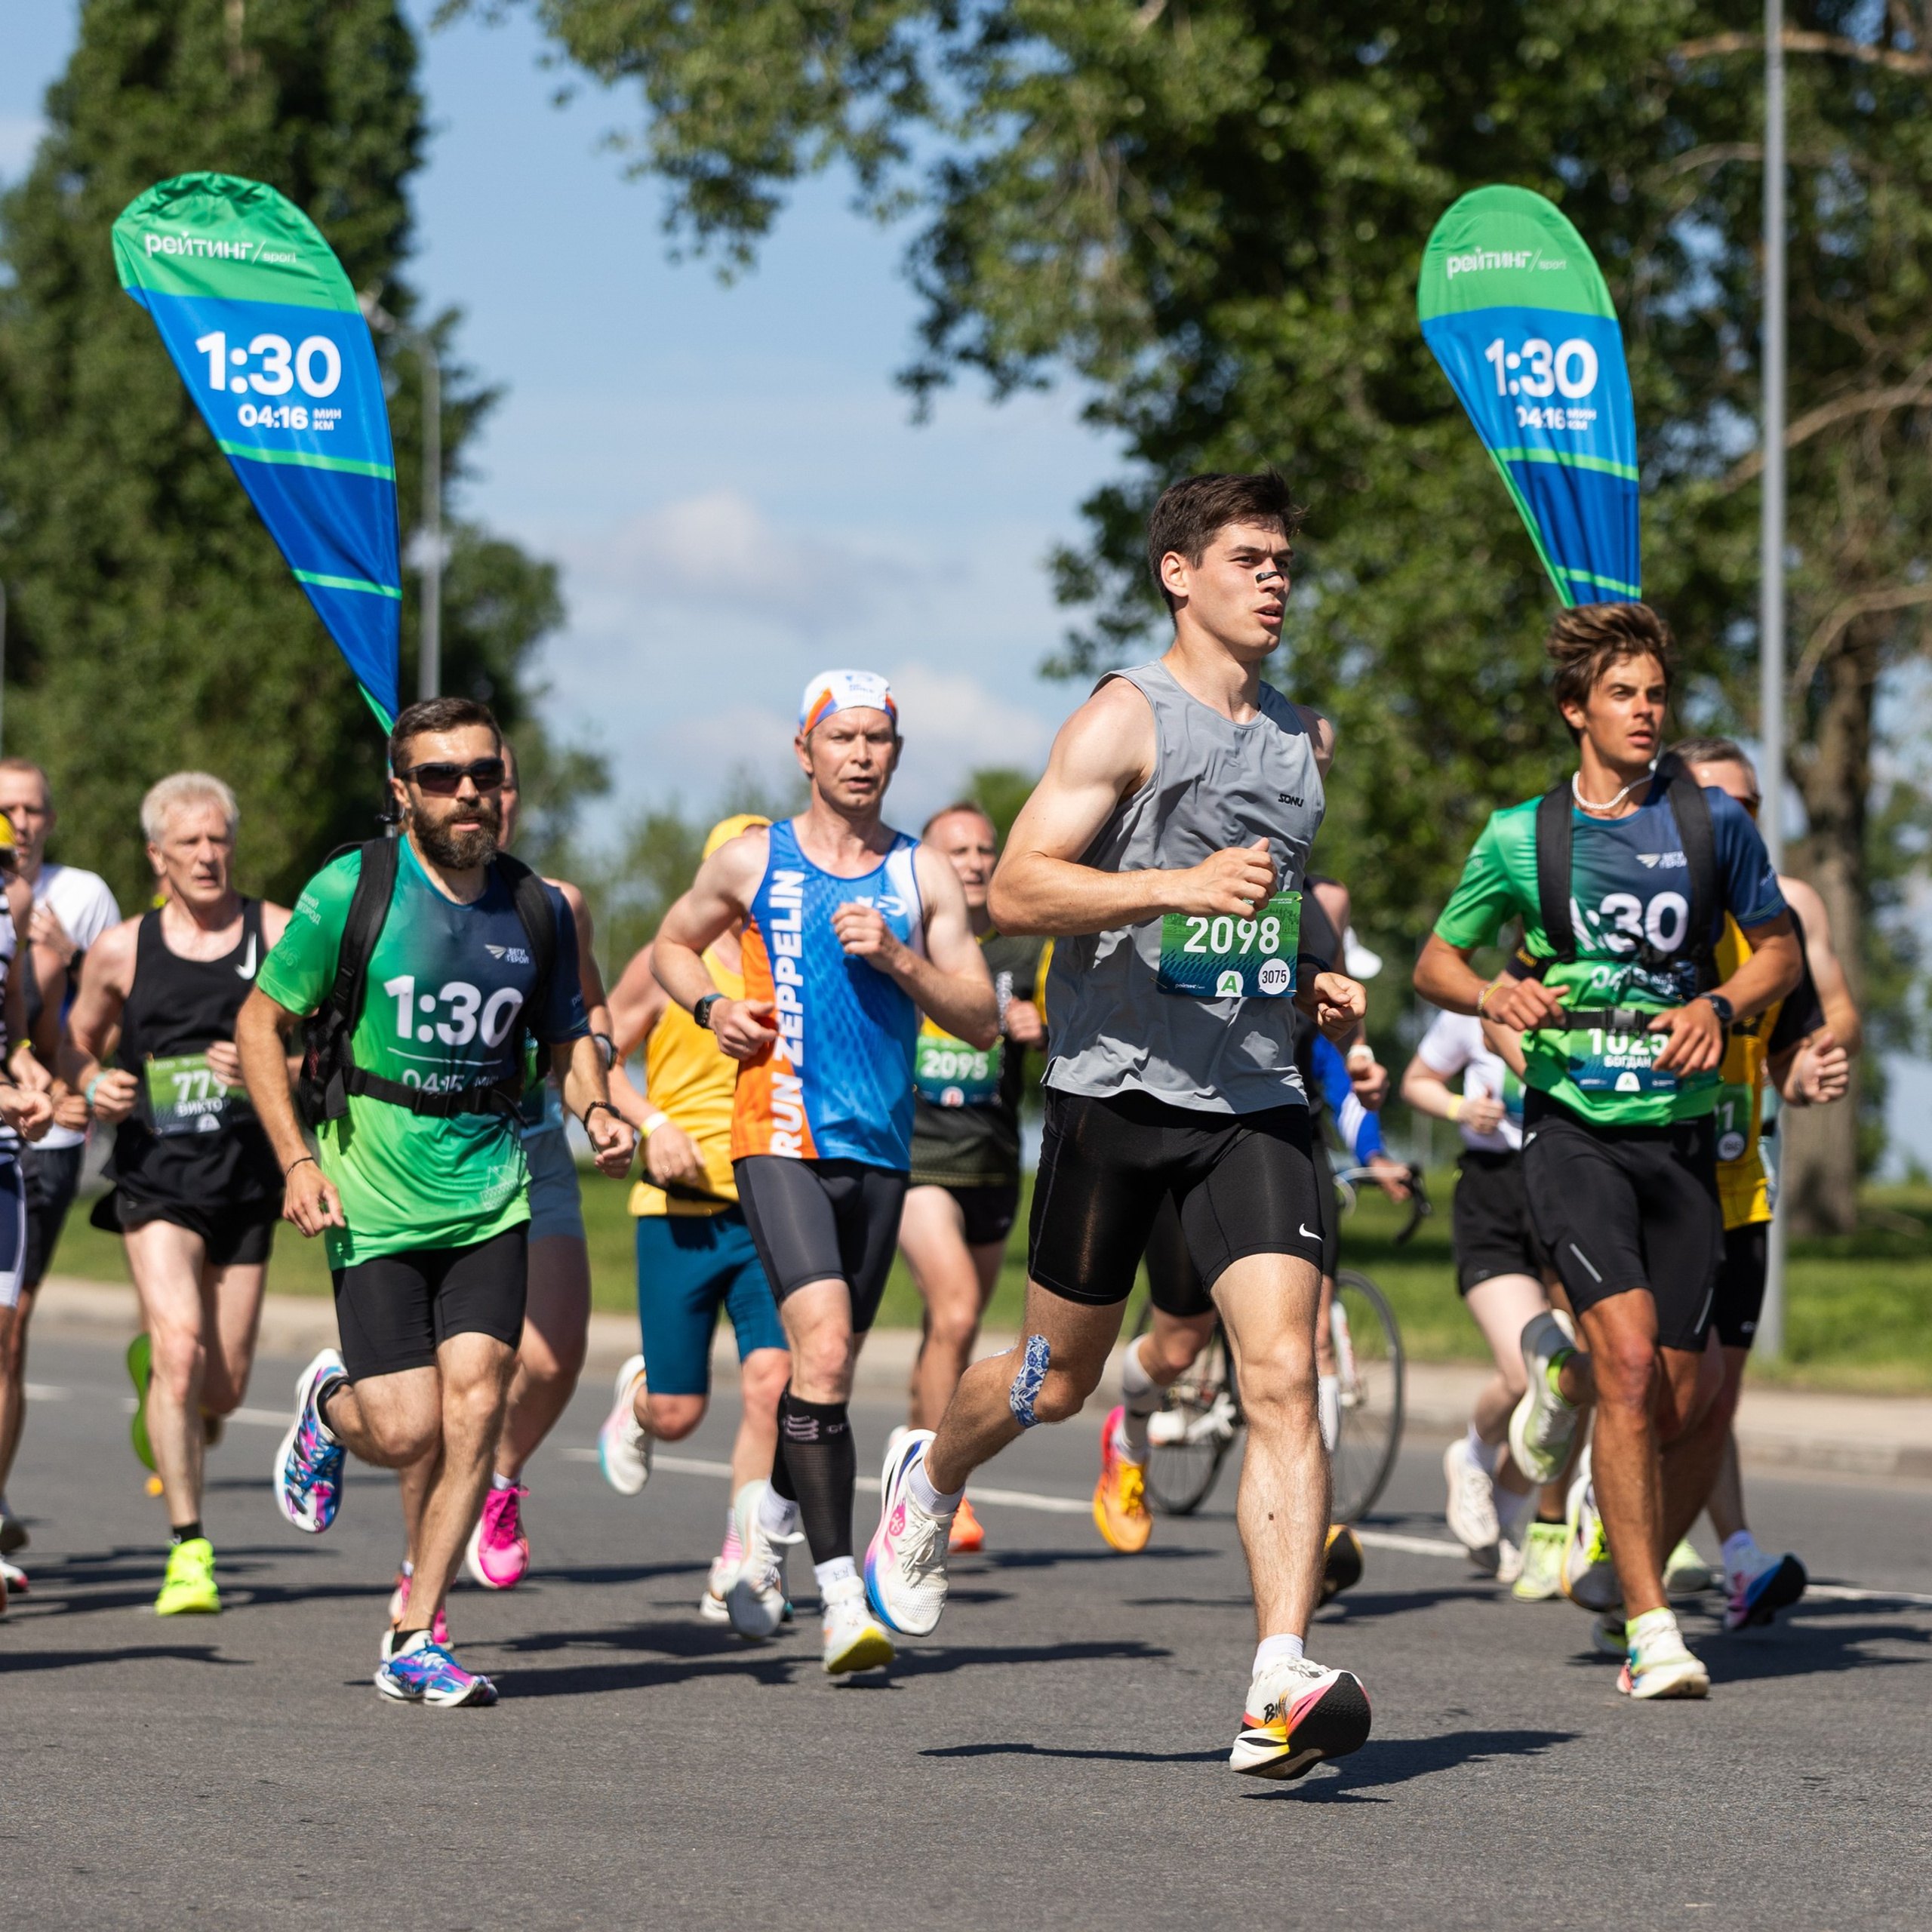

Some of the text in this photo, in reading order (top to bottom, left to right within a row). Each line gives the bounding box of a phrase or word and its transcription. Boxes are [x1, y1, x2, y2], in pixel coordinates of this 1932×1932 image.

[195, 331, 342, 398] 1:30
[1484, 337, 1598, 399] 1:30
[238, 404, 308, 430] 04:16
[1183, 916, 1281, 955] 2098
[1261, 970, 1287, 984] 3075
[383, 974, 524, 1048] 1:30
[769, 870, 805, 1159] RUN ZEPPELIN
[920, 1048, 989, 1081] 2095
[1604, 1055, 1651, 1070] БОГДАН
